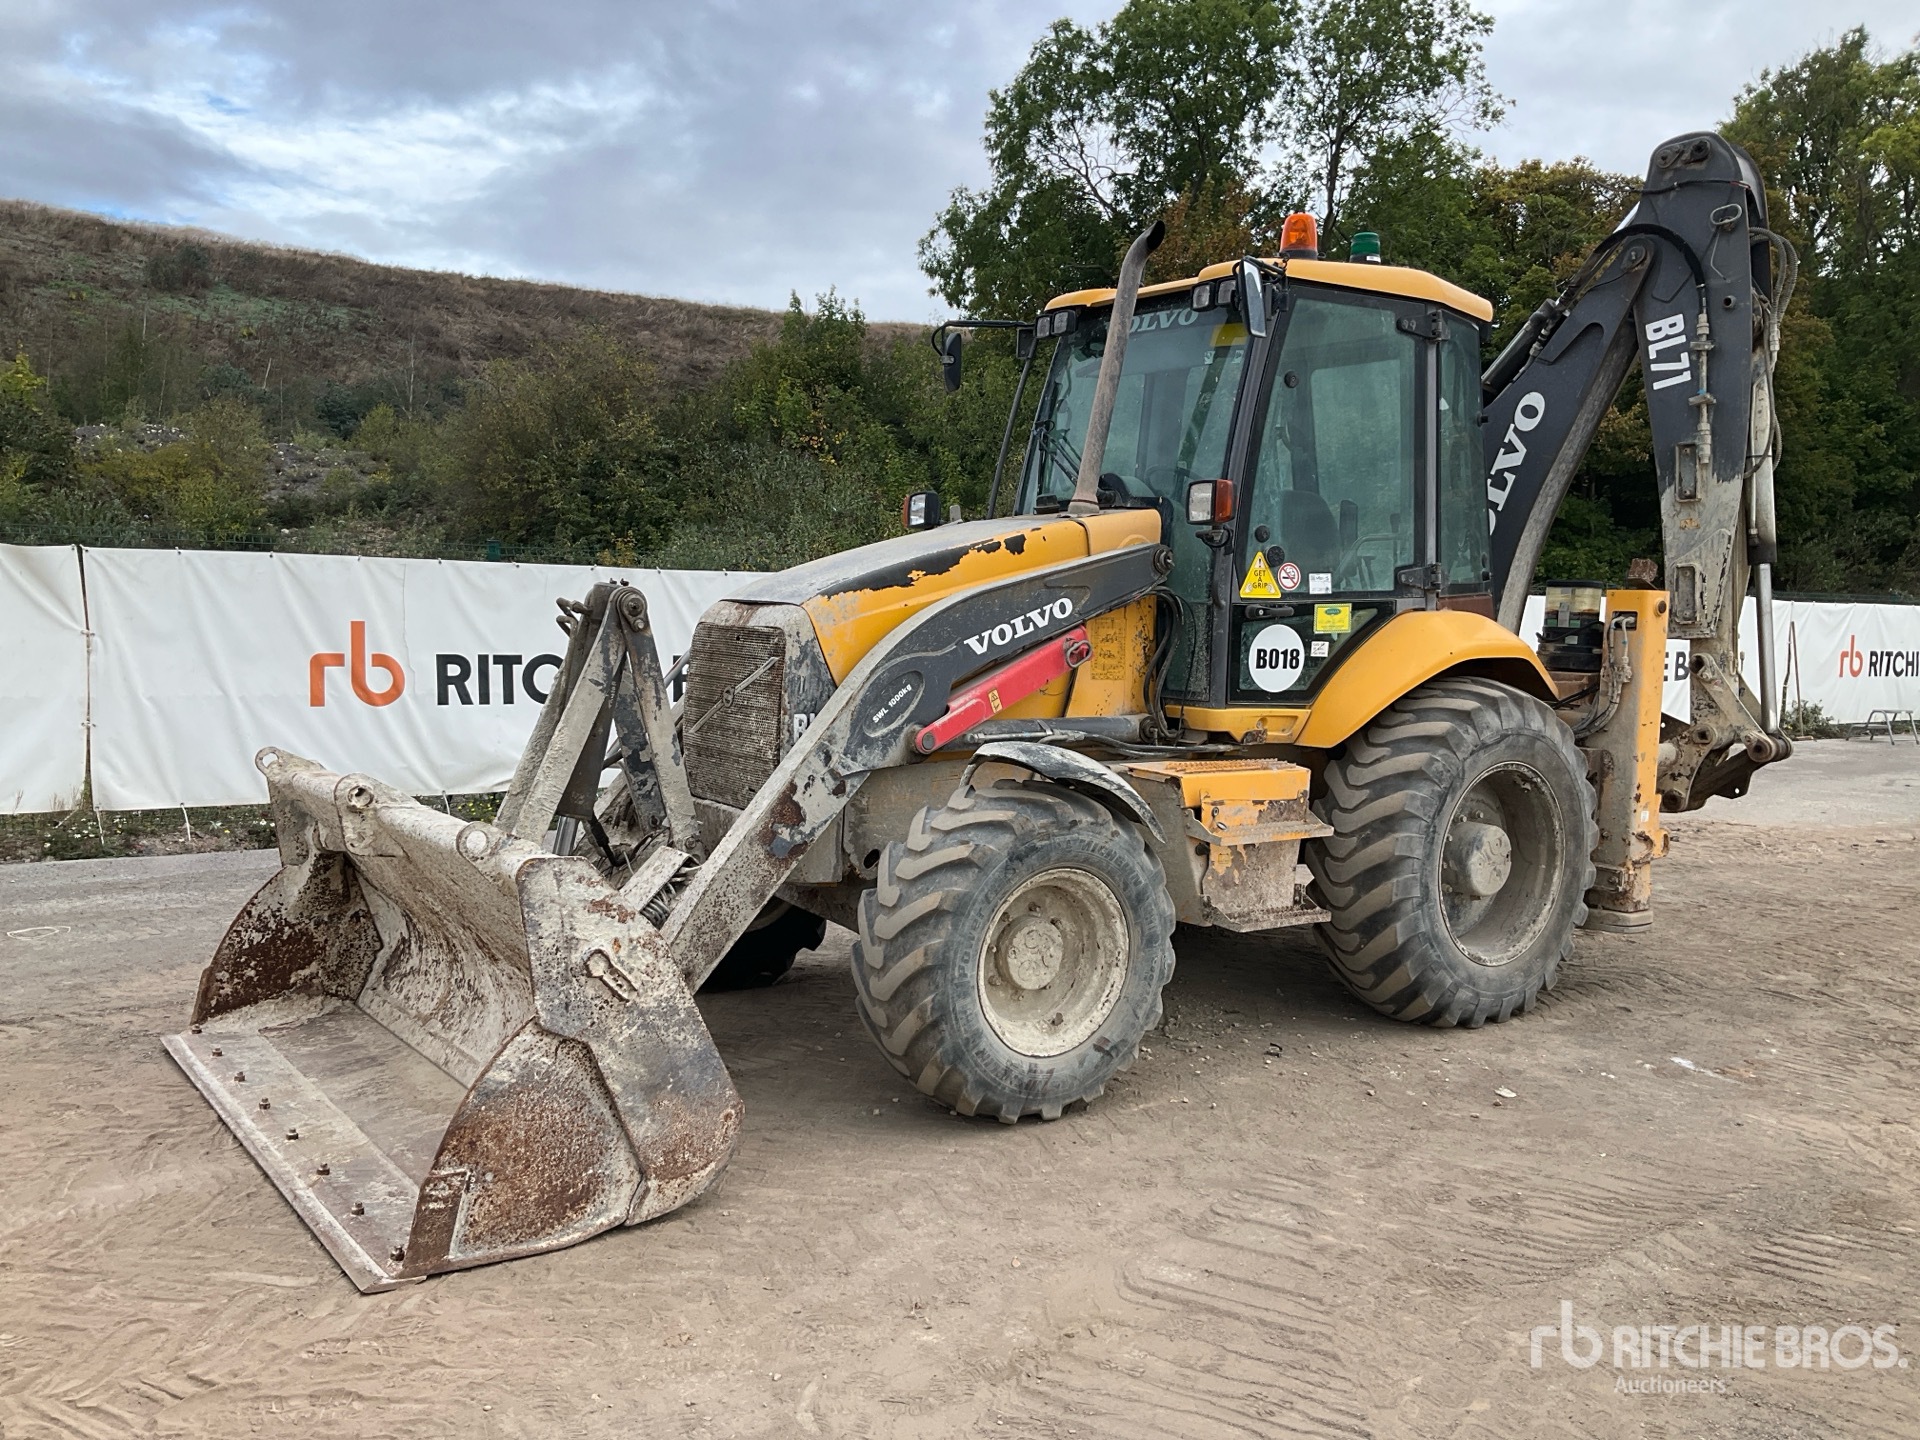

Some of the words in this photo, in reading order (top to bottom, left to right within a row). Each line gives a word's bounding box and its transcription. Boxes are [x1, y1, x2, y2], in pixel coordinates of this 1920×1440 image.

[1127, 308, 1199, 333] OLVO
[1645, 313, 1691, 390] BL71
[963, 597, 1073, 655] VOLVO
[309, 620, 405, 707] rb
[1839, 634, 1863, 677] rb
[1868, 650, 1919, 677] RITCHI
[872, 707, 889, 723] SWL
[888, 684, 912, 707] 1000kg
